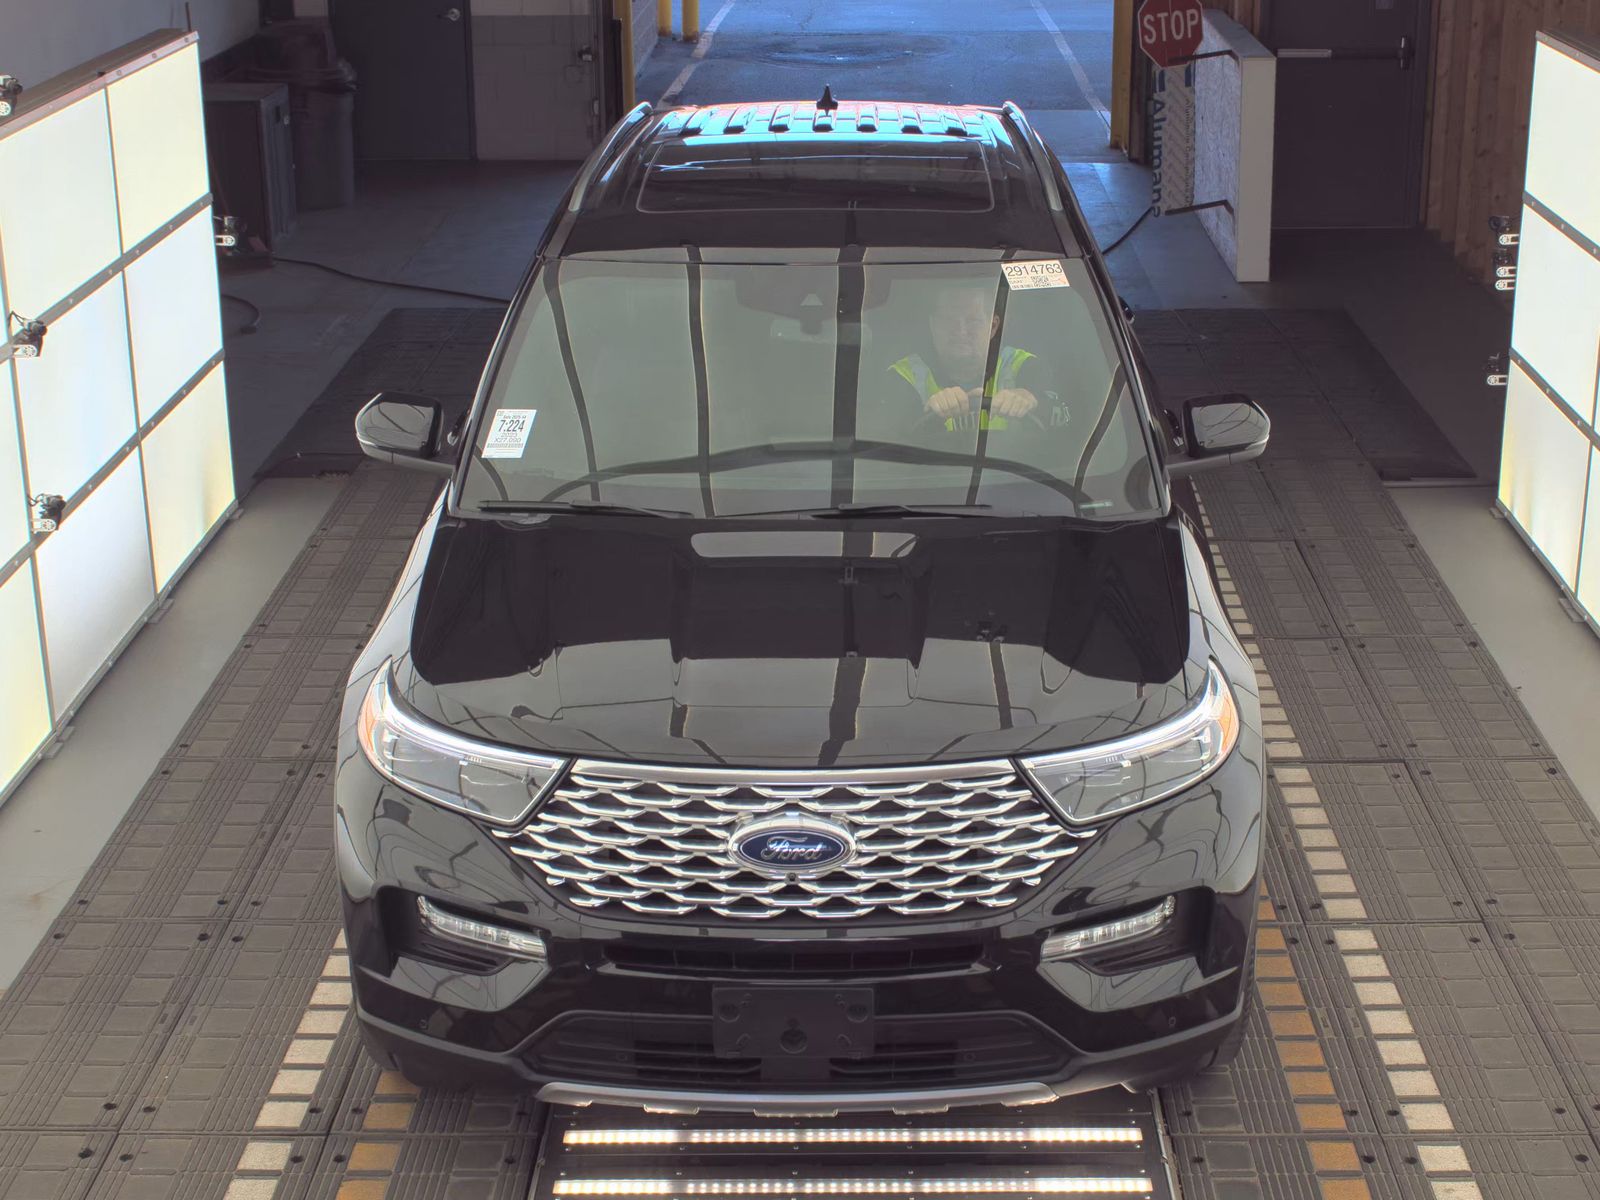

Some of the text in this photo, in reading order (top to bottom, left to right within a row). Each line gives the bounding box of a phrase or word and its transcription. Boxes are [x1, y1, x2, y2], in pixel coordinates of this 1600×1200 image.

[1143, 8, 1199, 44] STOP
[1005, 263, 1063, 277] 2914763
[760, 836, 824, 860] Ford
